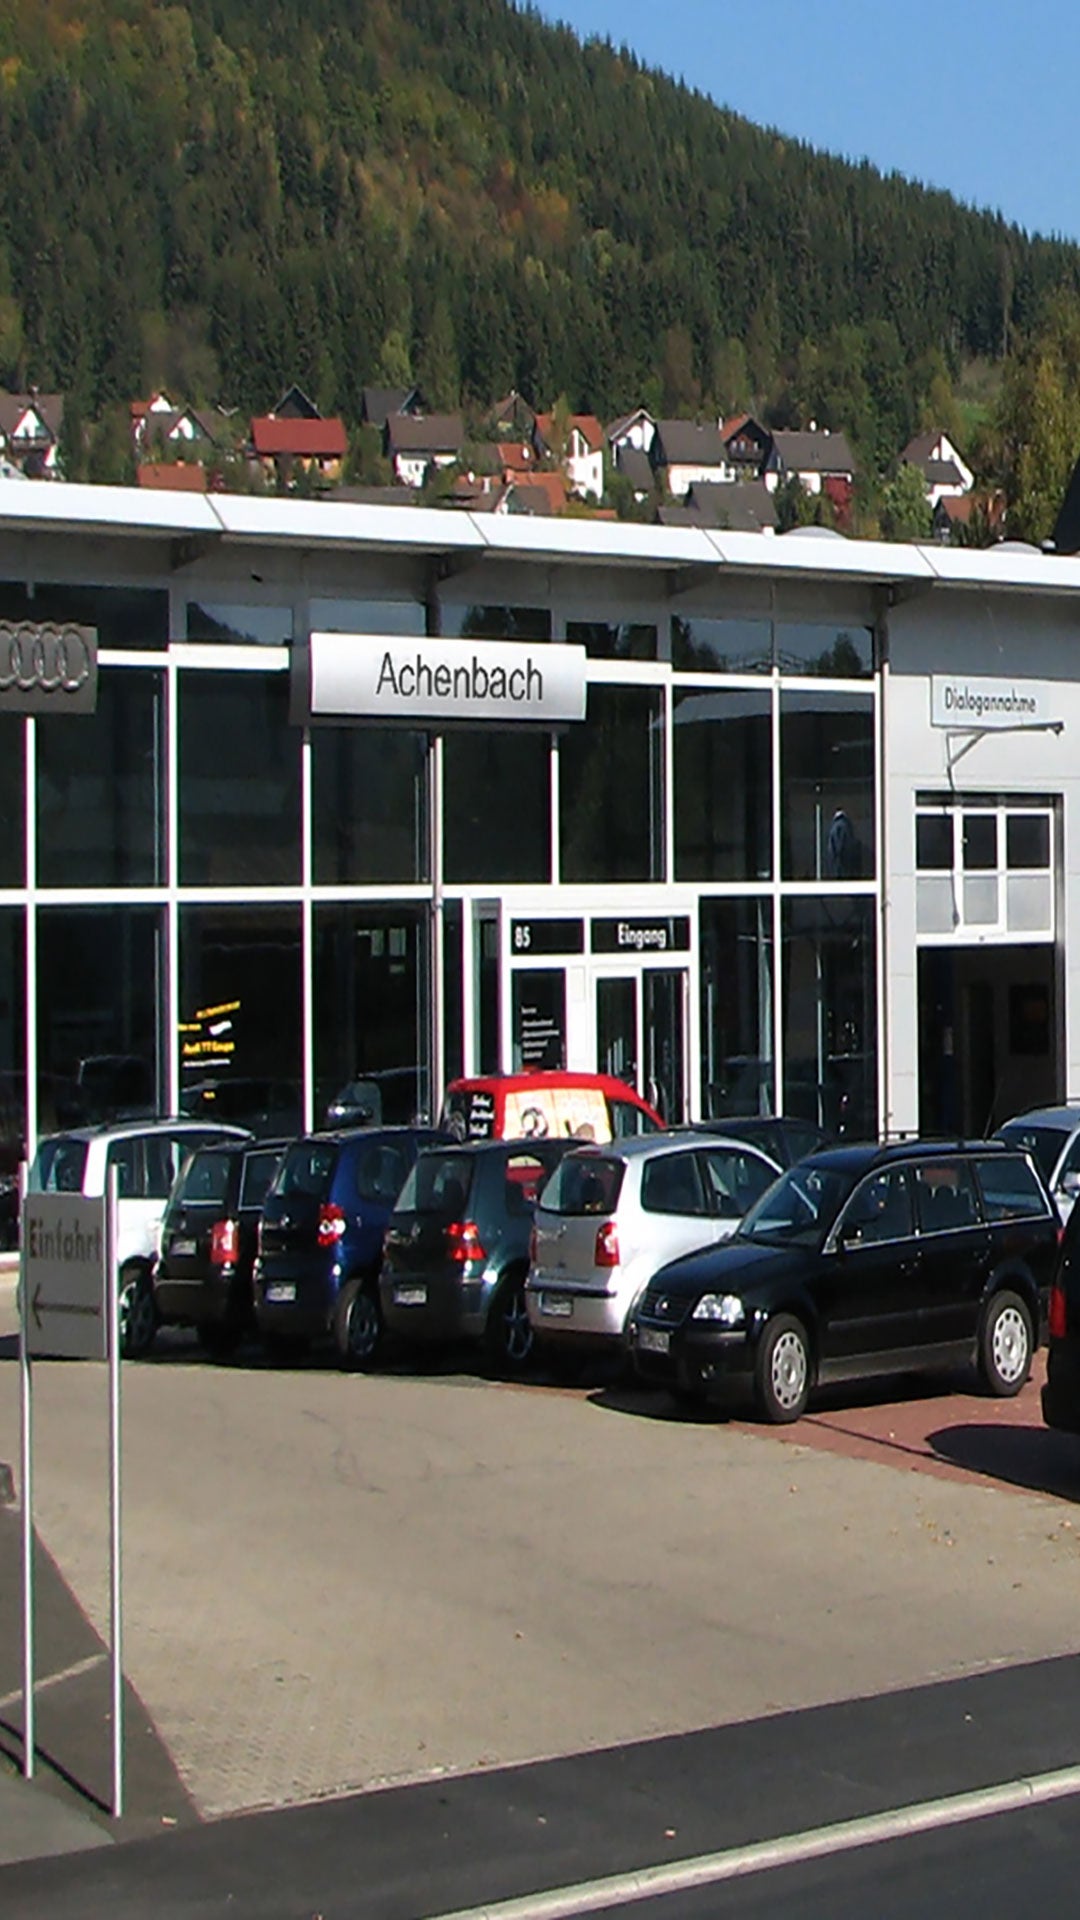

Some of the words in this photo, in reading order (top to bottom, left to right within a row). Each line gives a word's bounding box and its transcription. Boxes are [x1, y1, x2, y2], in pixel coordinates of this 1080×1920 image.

[376, 651, 543, 700] Achenbach
[945, 686, 1036, 717] Dialogannahme
[514, 926, 531, 948] 85
[617, 923, 667, 949] Eingang
[29, 1219, 102, 1262] Einfahrt
